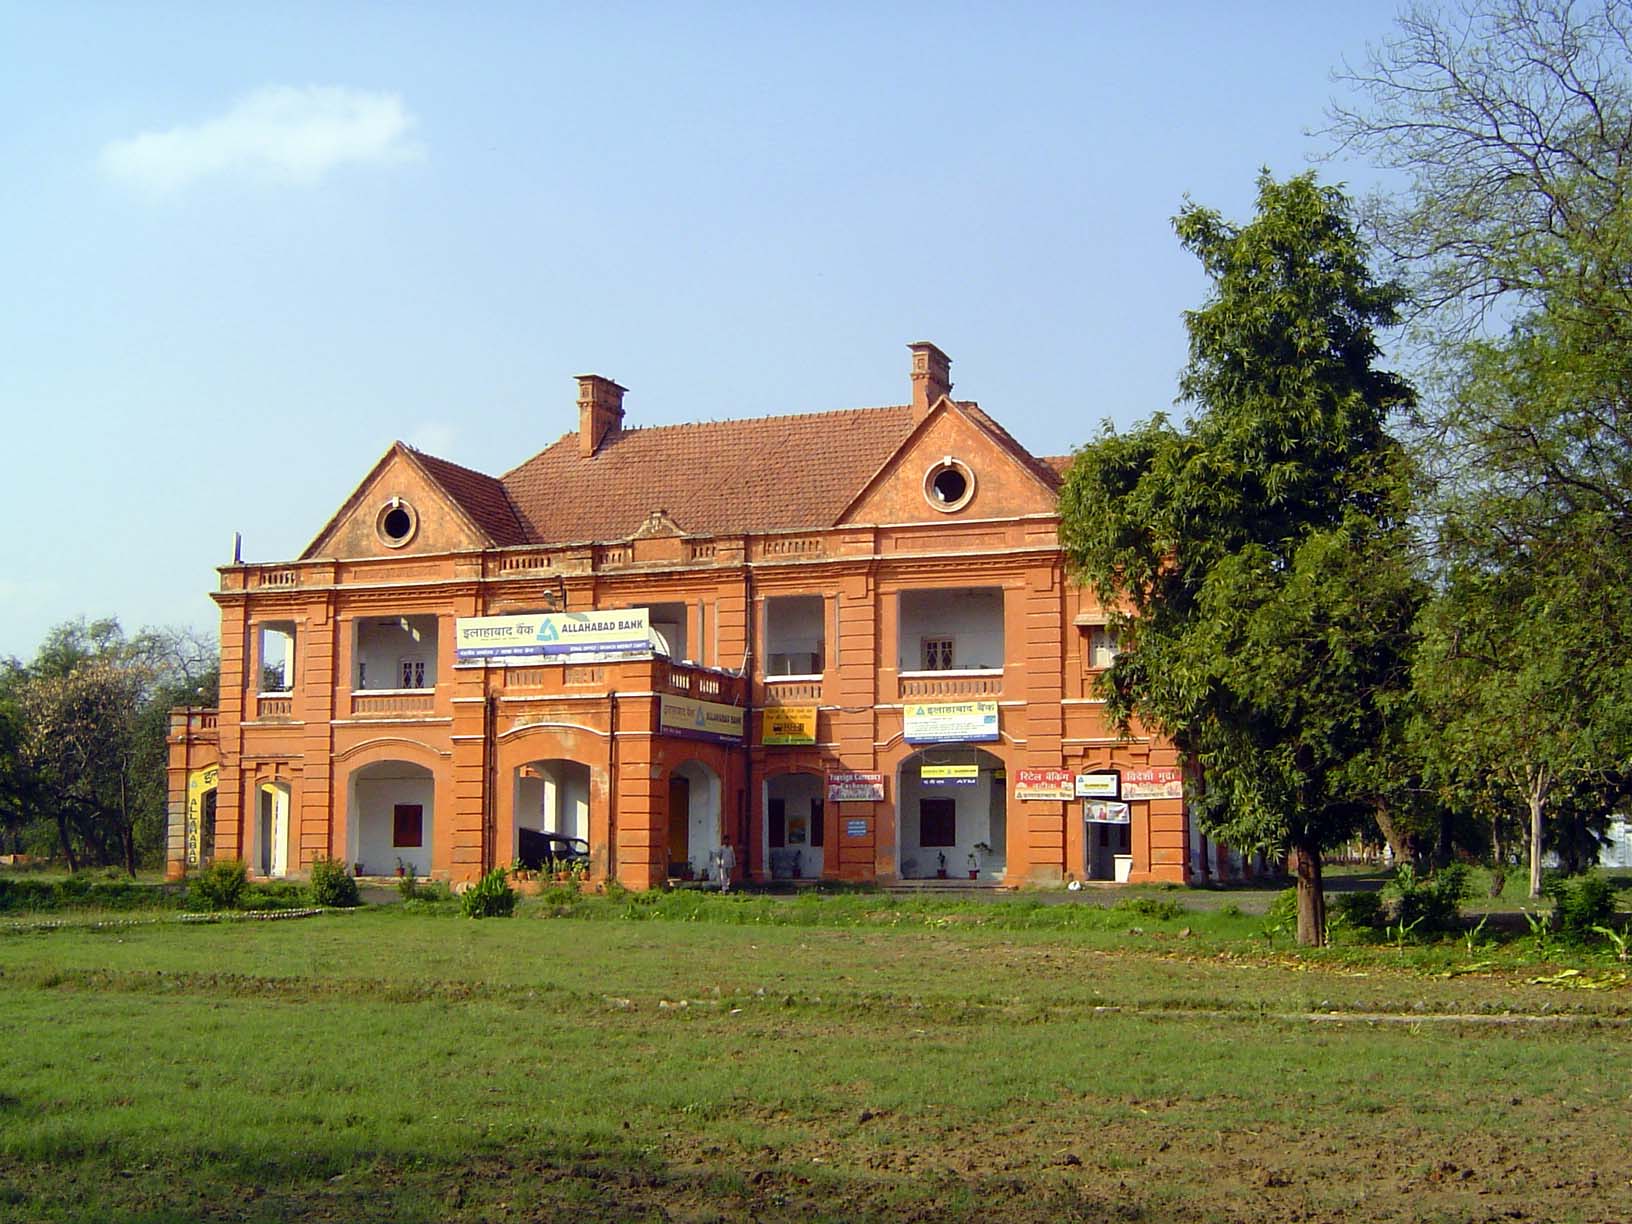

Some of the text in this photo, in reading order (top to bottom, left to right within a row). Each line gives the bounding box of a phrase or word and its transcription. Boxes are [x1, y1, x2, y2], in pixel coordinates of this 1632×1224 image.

[463, 626, 513, 639] इलाहाबाद
[561, 619, 643, 633] ALLAHABAD BANK
